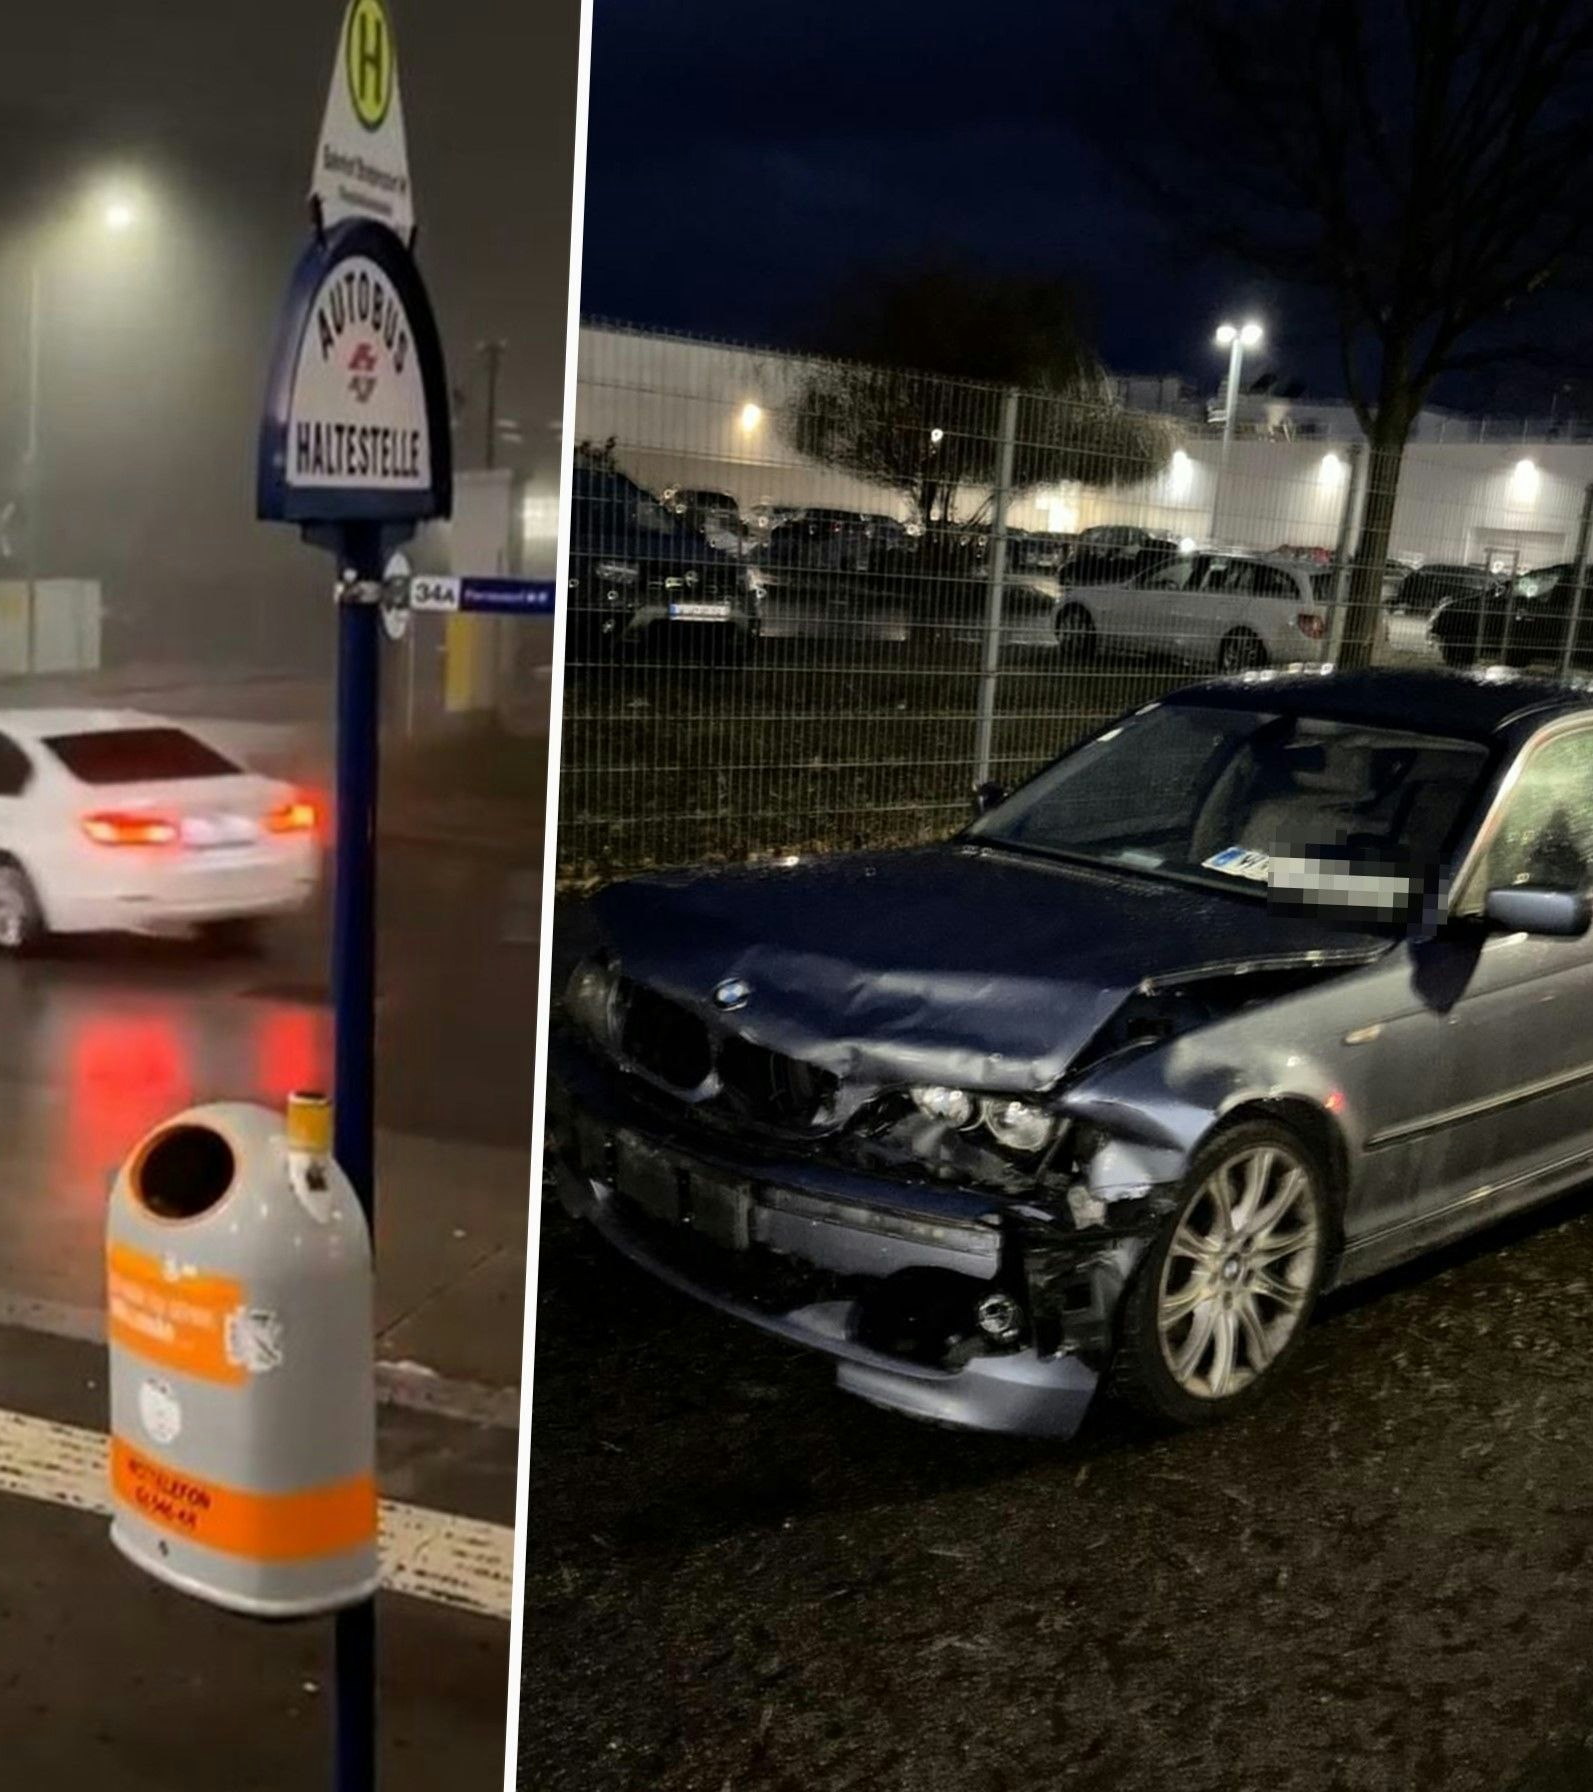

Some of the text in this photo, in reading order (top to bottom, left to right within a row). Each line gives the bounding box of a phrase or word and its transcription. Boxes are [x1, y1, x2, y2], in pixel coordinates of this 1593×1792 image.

[360, 12, 382, 105] H
[317, 270, 406, 375] AUTOBUS
[296, 421, 419, 479] HALTESTELLE
[414, 581, 455, 605] 34A
